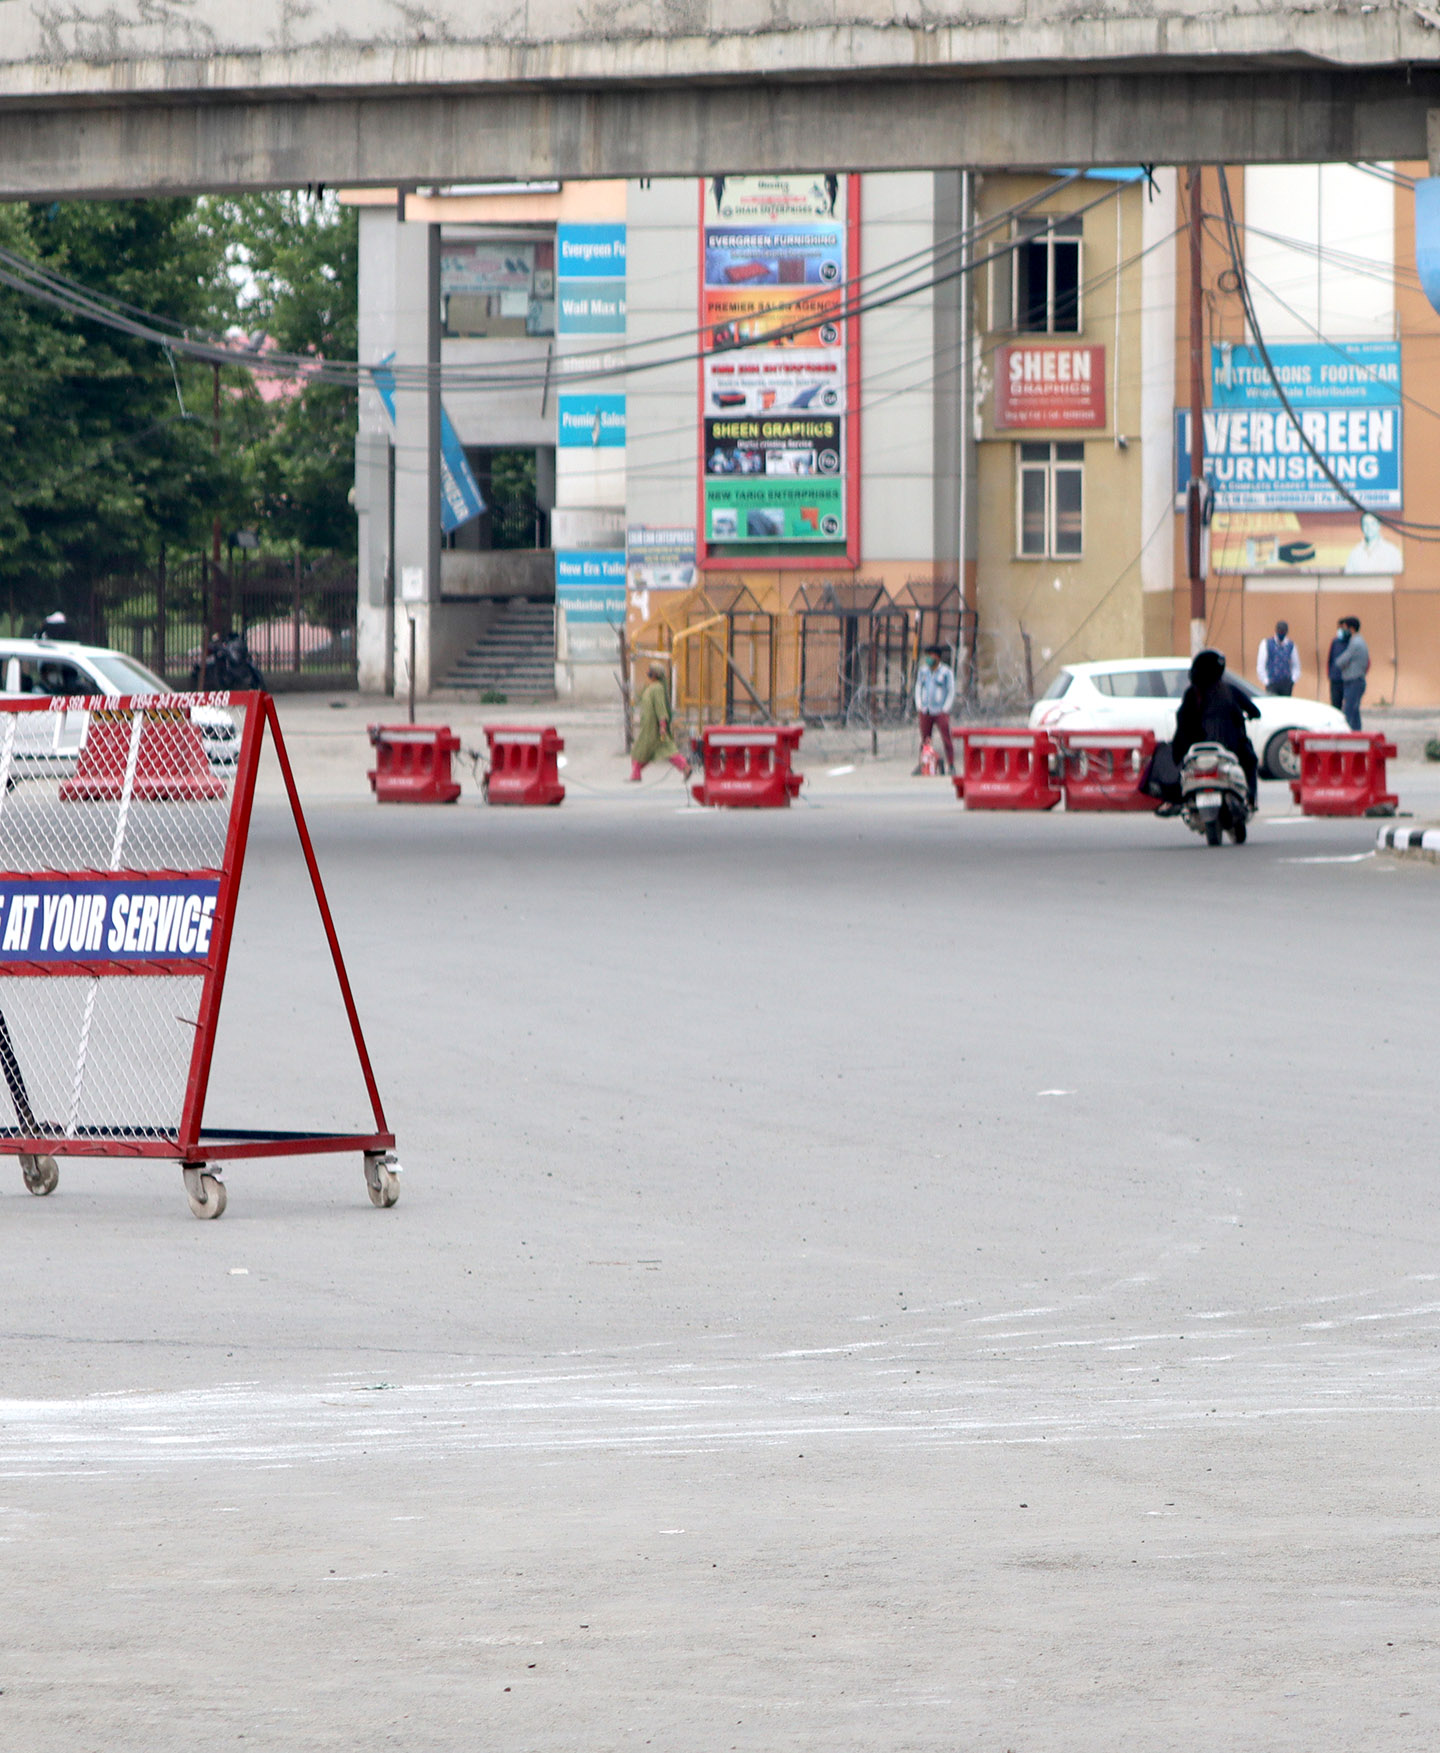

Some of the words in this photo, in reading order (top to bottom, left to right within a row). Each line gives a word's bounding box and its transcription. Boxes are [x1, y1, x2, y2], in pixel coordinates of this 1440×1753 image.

[562, 241, 611, 261] Evergreen
[709, 235, 771, 247] EVERGREEN
[773, 235, 837, 246] FURNISHING
[562, 300, 588, 316] Wall
[591, 300, 615, 316] Max
[708, 302, 755, 312] PREMIER
[1009, 350, 1092, 382] SHEEN
[1320, 363, 1398, 384] FOOTWEAR
[712, 422, 760, 438] SHEEN
[1185, 410, 1393, 454] VERGREEN
[1202, 454, 1380, 481] FURNISHING
[559, 561, 582, 576] New
[583, 561, 601, 575] Era
[2, 894, 40, 952] AT
[40, 894, 108, 952] YOUR
[107, 893, 217, 954] SERVICE
